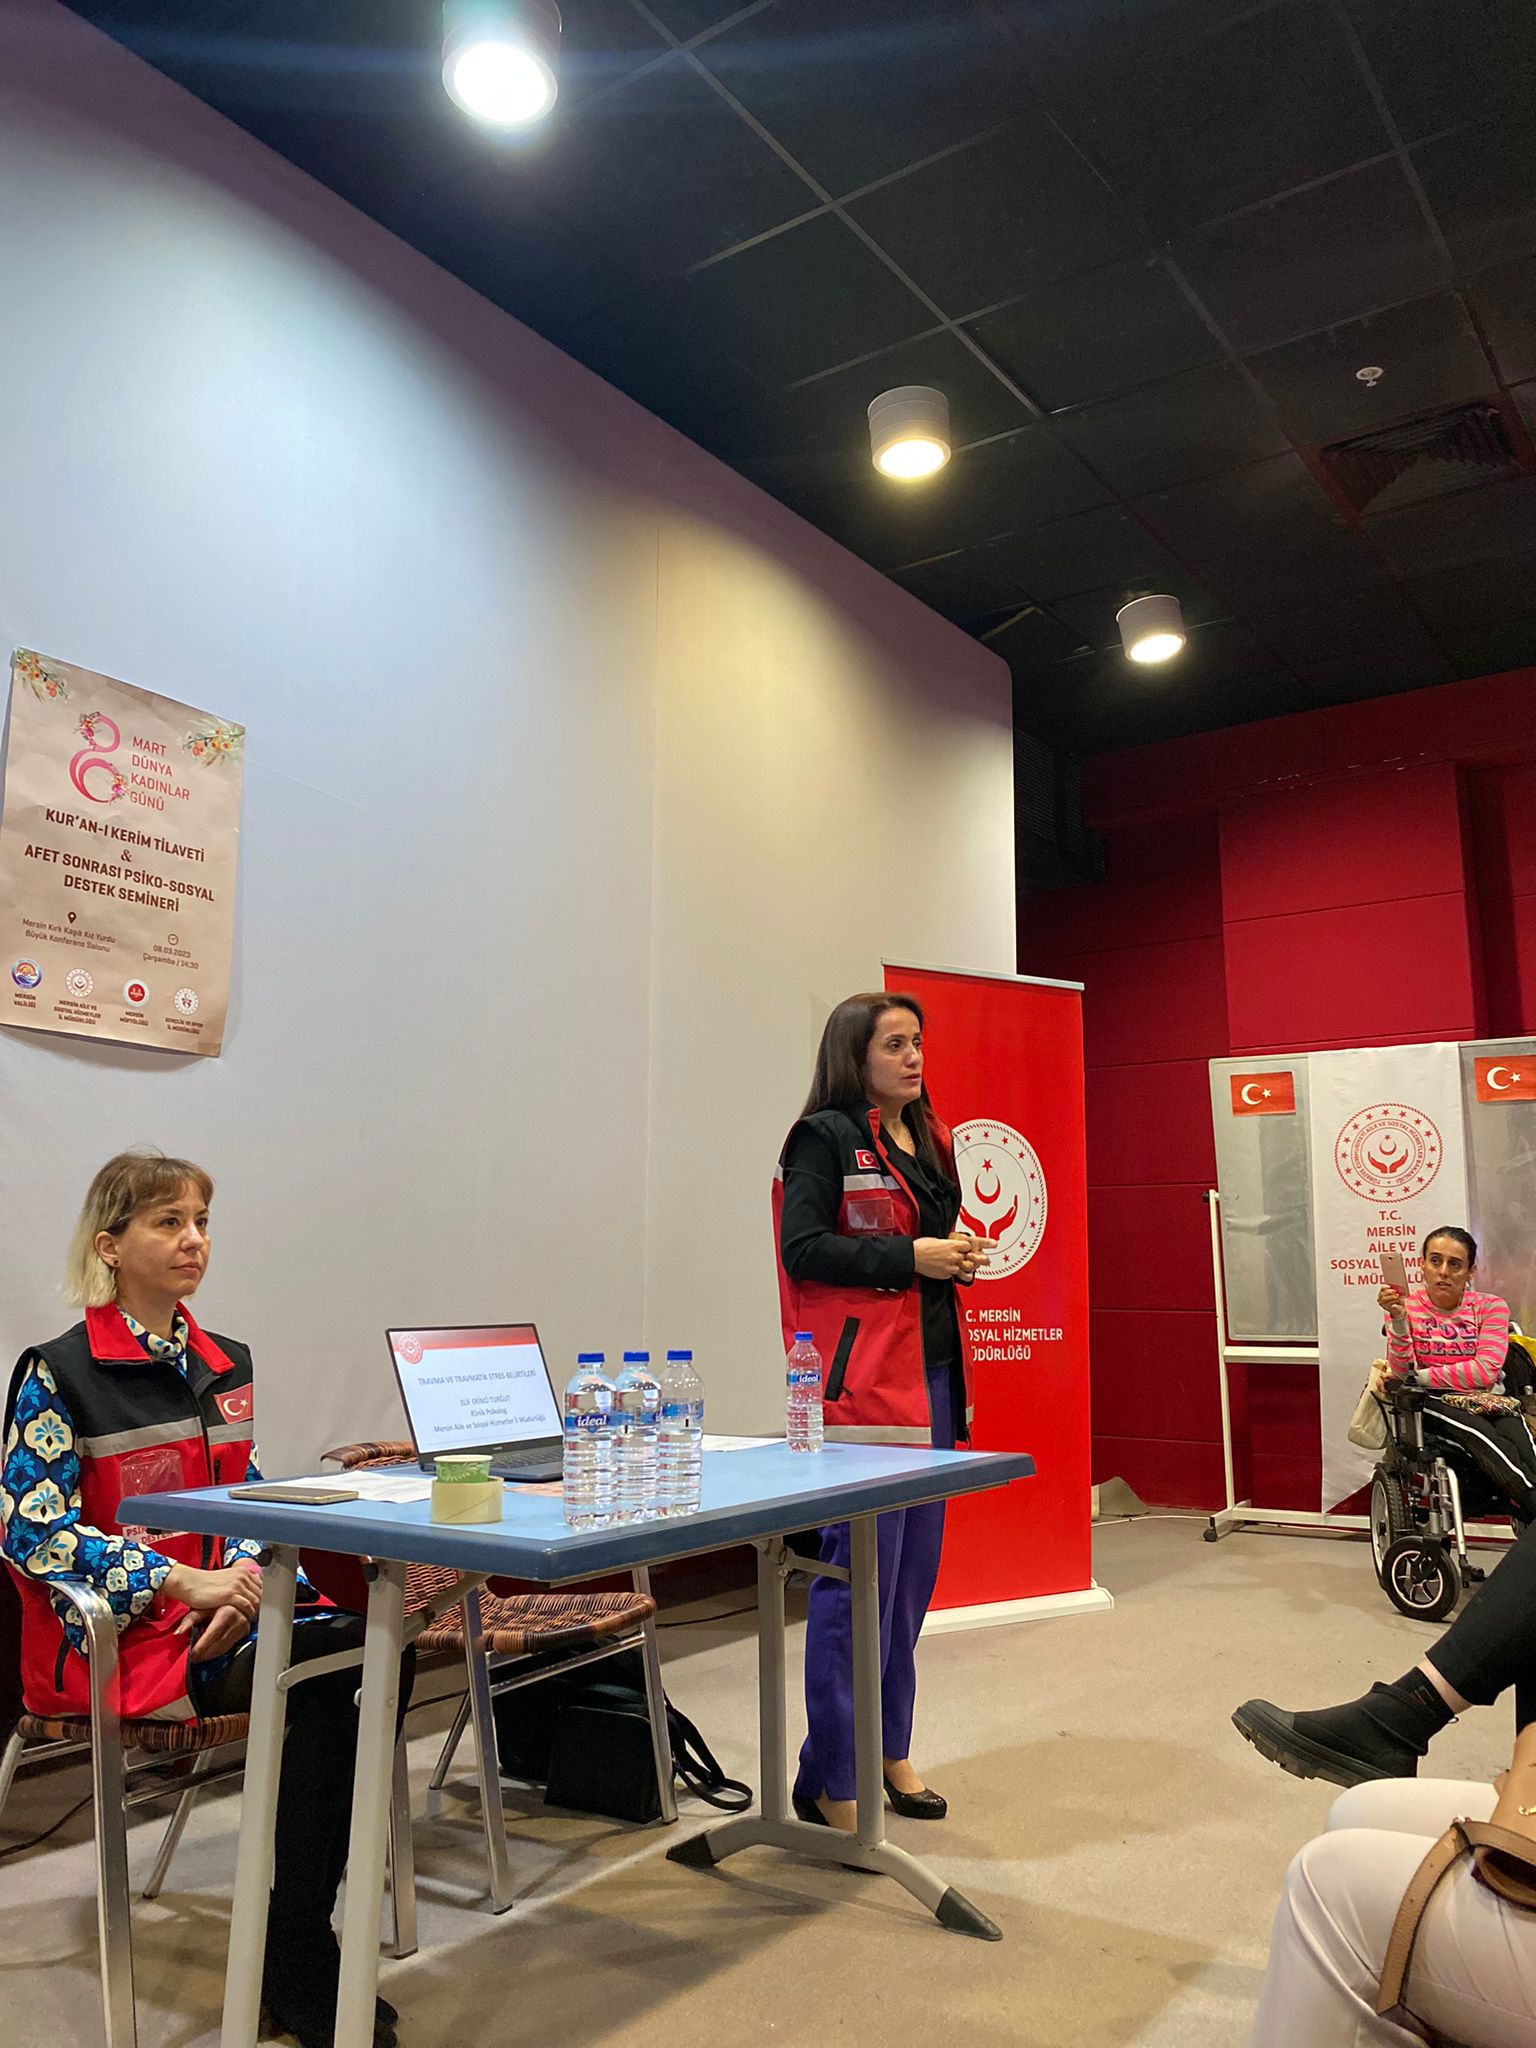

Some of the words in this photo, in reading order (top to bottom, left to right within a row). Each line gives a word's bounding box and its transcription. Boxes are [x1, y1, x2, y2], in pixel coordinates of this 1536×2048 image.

[133, 736, 167, 756] MART
[132, 754, 173, 777] DÜNYA
[131, 773, 190, 801] KADINLAR
[130, 791, 164, 811] GÜNÜ
[46, 808, 108, 837] KUR'AN-I
[111, 826, 151, 848] KERİM
[154, 837, 204, 862] TİLAVETİ
[121, 849, 132, 862] &
[24, 844, 60, 863] AFET
[62, 853, 121, 879] SONRASI
[124, 869, 214, 902] PSİKO-SOSYAL
[64, 874, 116, 898] DESTEK
[118, 887, 179, 912] SEMİNERİ
[22, 918, 47, 930] Mersin
[48, 923, 62, 932] Kırk
[84, 930, 94, 939] Kız
[96, 932, 116, 943] Yurdu
[25, 929, 48, 941] Büyük
[49, 934, 86, 948] Konferans
[87, 941, 111, 952] Salonu
[14, 992, 36, 1000] MERSİN
[1379, 1210, 1401, 1220] T.C.
[1367, 1224, 1416, 1237] MERSİN
[1368, 1240, 1396, 1253] AİLE
[1399, 1241, 1416, 1252] VE
[1330, 1259, 1379, 1270] SOSYAL
[1343, 1273, 1355, 1285] İL
[965, 1309, 977, 1322] C.
[979, 1306, 1021, 1322] MERSİN
[968, 1328, 1001, 1342] SYAL
[1003, 1325, 1063, 1341] HİZMETLER
[971, 1344, 1031, 1362] ÜDÜRLÜĞÜ
[446, 1376, 455, 1384] VE
[488, 1372, 505, 1381] STRES
[799, 1374, 819, 1383] ideal
[576, 1414, 608, 1428] ideal
